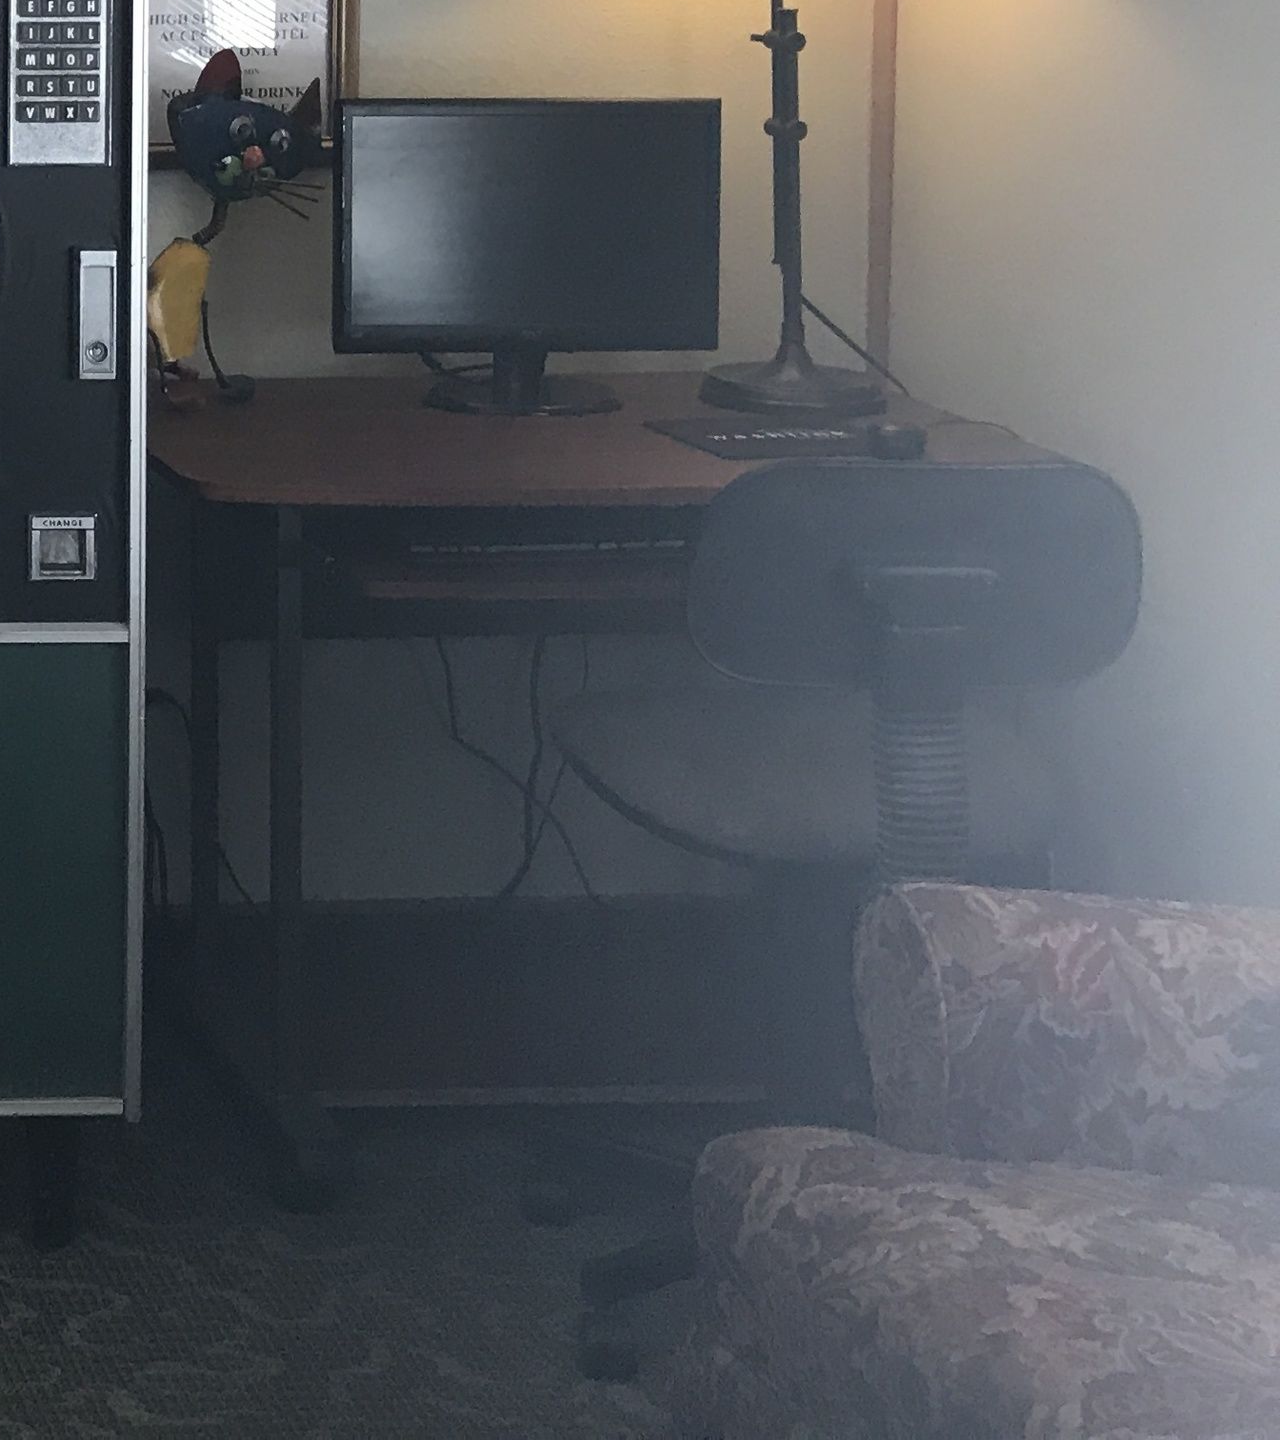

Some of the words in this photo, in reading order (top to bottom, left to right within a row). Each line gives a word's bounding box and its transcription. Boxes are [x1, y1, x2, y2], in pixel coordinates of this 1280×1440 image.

[28, 1, 34, 12] E
[48, 1, 54, 12] F
[67, 1, 75, 12] G
[87, 1, 95, 12] H
[29, 28, 33, 39] I
[48, 28, 54, 39] J
[67, 28, 75, 39] K
[89, 28, 94, 39] L
[240, 46, 279, 58] ONLY
[26, 54, 36, 66] M
[47, 54, 55, 65] N
[66, 54, 75, 65] O
[86, 54, 94, 65] P
[27, 81, 34, 92] R
[47, 81, 53, 92] S
[68, 81, 75, 92] T
[87, 81, 95, 92] U
[26, 107, 34, 118] V
[45, 107, 55, 118] W
[66, 107, 74, 118] X
[87, 107, 94, 118] Y
